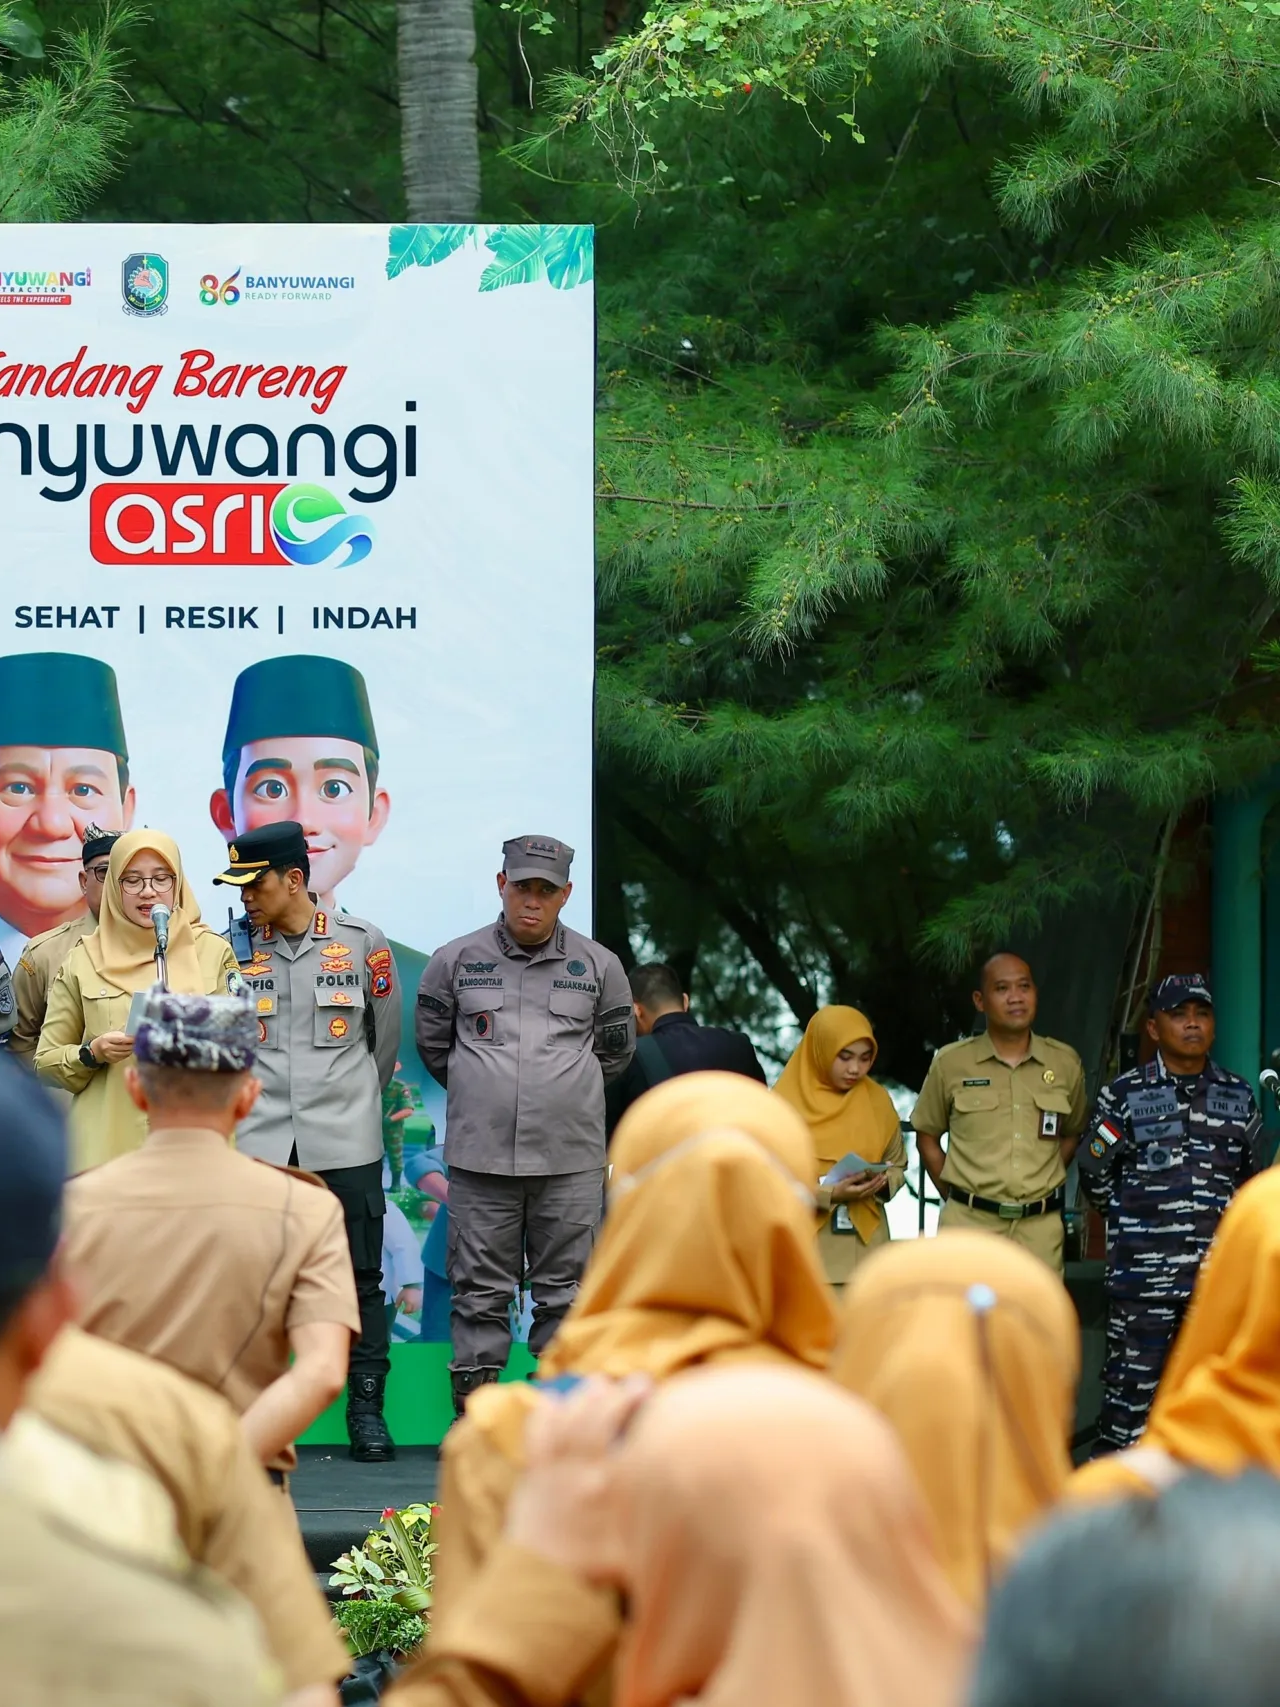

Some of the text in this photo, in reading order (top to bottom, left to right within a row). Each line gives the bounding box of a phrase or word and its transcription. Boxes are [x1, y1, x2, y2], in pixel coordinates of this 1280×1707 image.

[198, 266, 242, 306] 86
[245, 276, 355, 289] BANYUWANGI
[13, 295, 24, 303] THE
[245, 292, 332, 301] READY FORWARD
[173, 349, 348, 414] Bareng
[103, 493, 264, 554] asri
[14, 606, 121, 629] SEHAT
[165, 606, 260, 630] RESIK
[312, 607, 417, 630] INDAH
[316, 974, 360, 987] POLRI
[553, 980, 597, 994] KEJAKSAAN
[1133, 1102, 1175, 1117] RIYANTO
[1212, 1101, 1246, 1114] TNI AL
